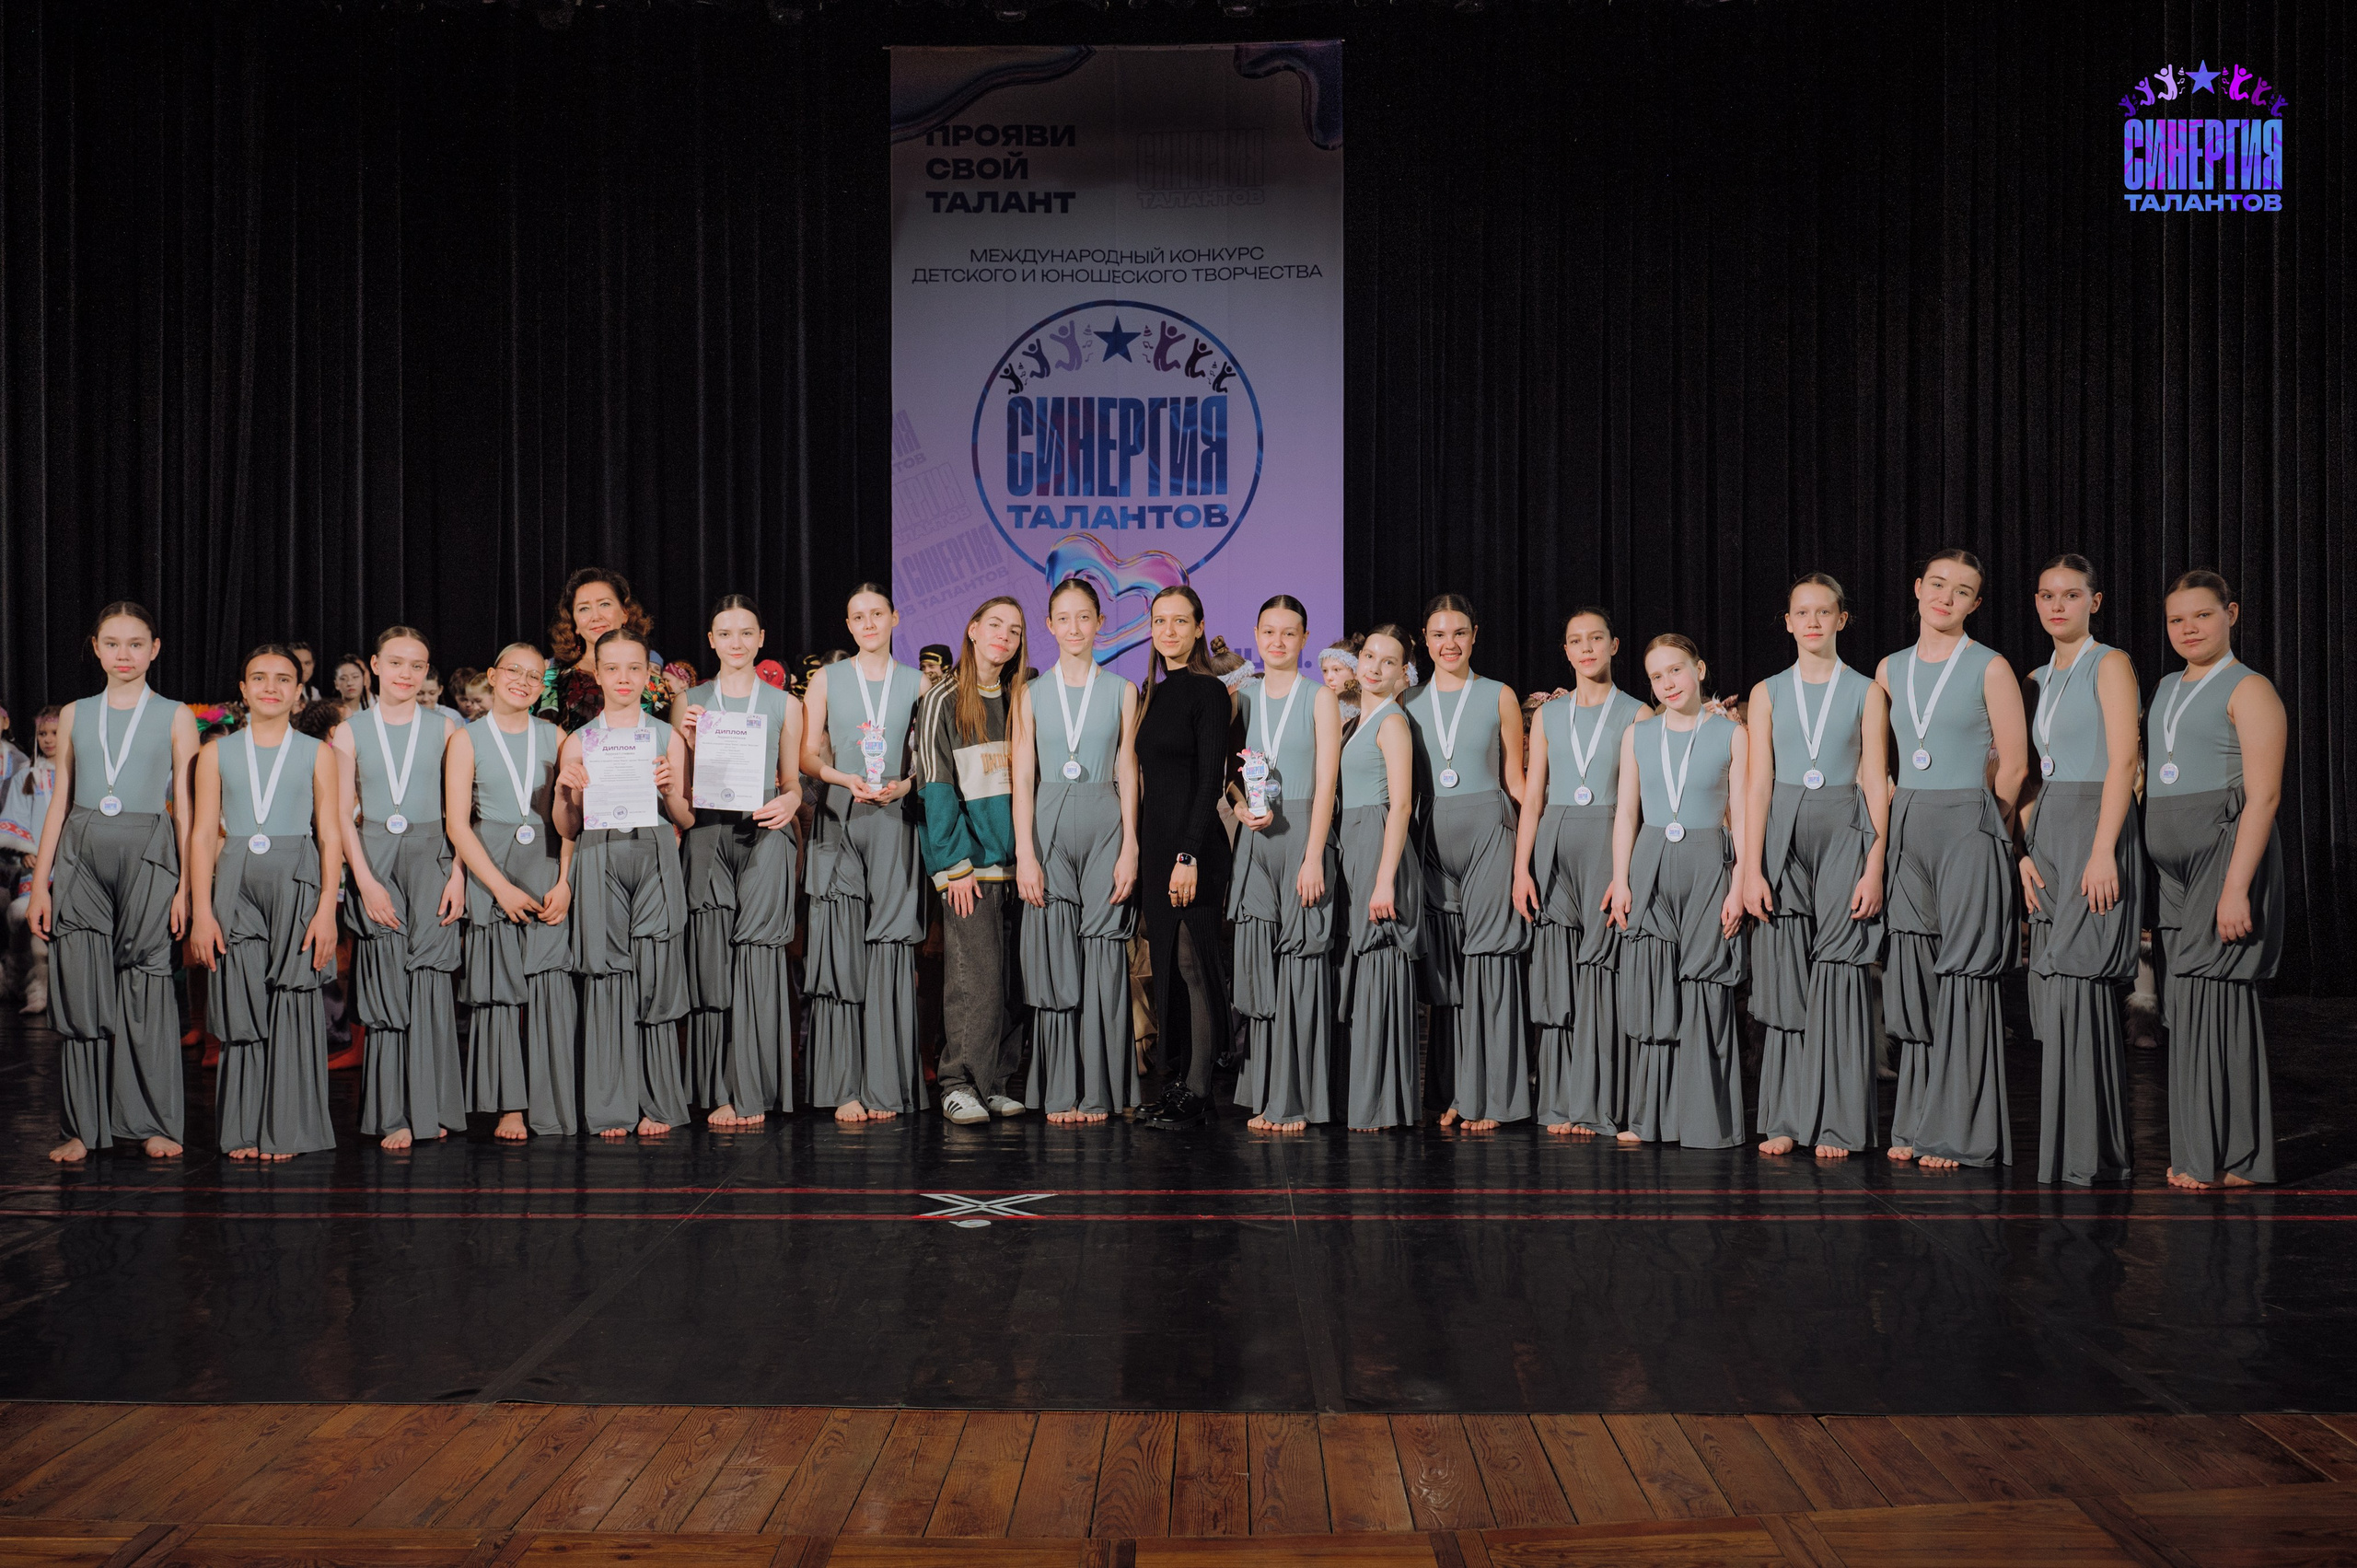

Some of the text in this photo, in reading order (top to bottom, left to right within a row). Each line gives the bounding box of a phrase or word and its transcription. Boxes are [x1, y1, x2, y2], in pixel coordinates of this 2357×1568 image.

[926, 124, 1076, 147] ПРОЯВИ
[925, 151, 1028, 180] СВОЙ
[925, 191, 1076, 214] ТАЛАНТ
[970, 246, 1265, 267] МЕЖДУНАРОДНЫЙ КОНКУРС
[911, 263, 1324, 285] ДЕТСКОГО И ЮНОШЕСКОГО ТВОРЧЕСТВА
[1006, 395, 1229, 497] СИНЕРГИЯ
[1006, 504, 1229, 529] ТАЛАНТОВ
[918, 565, 1010, 610] ТАЛАНТОВ
